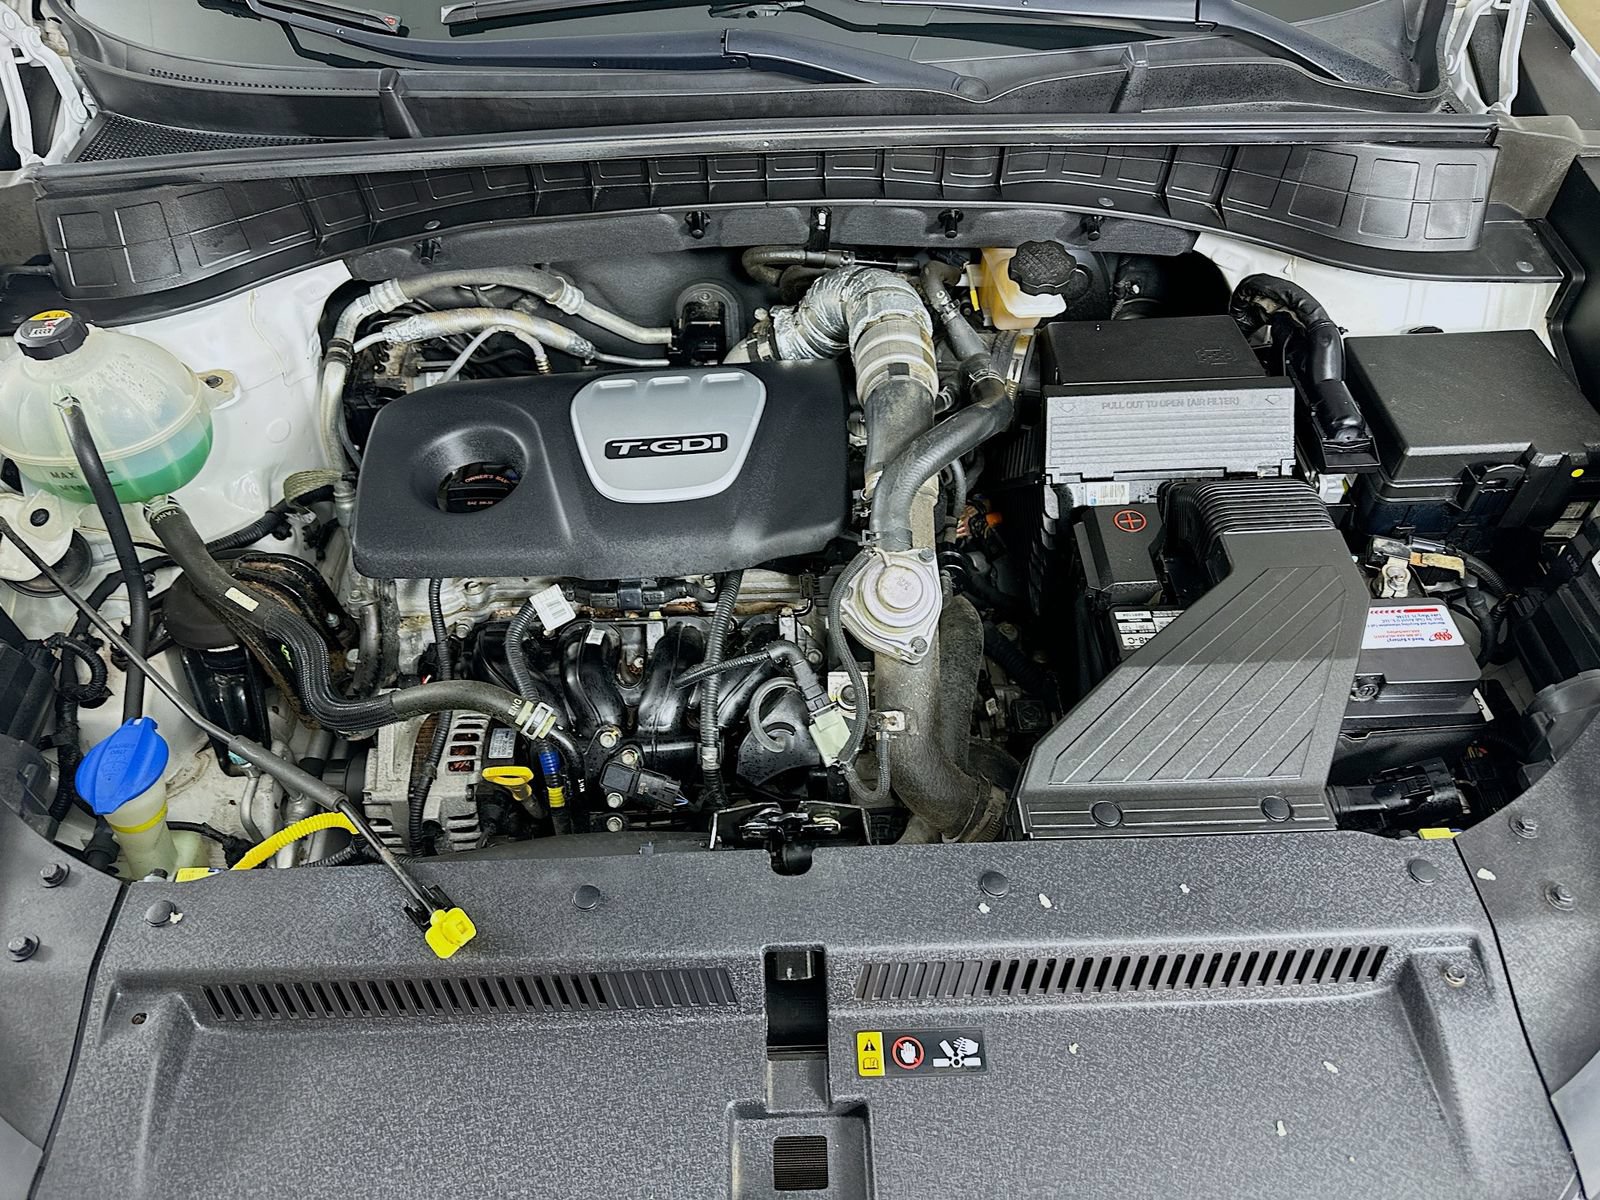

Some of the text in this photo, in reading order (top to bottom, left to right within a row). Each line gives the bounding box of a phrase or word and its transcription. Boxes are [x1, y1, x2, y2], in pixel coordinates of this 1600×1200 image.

[1102, 401, 1125, 409] PULL
[1126, 400, 1144, 409] OUT
[1145, 400, 1158, 408] TO
[1159, 399, 1184, 407] OPEN
[611, 436, 721, 456] T-GDI
[49, 471, 78, 479] MAX
[154, 508, 179, 524] TANK
